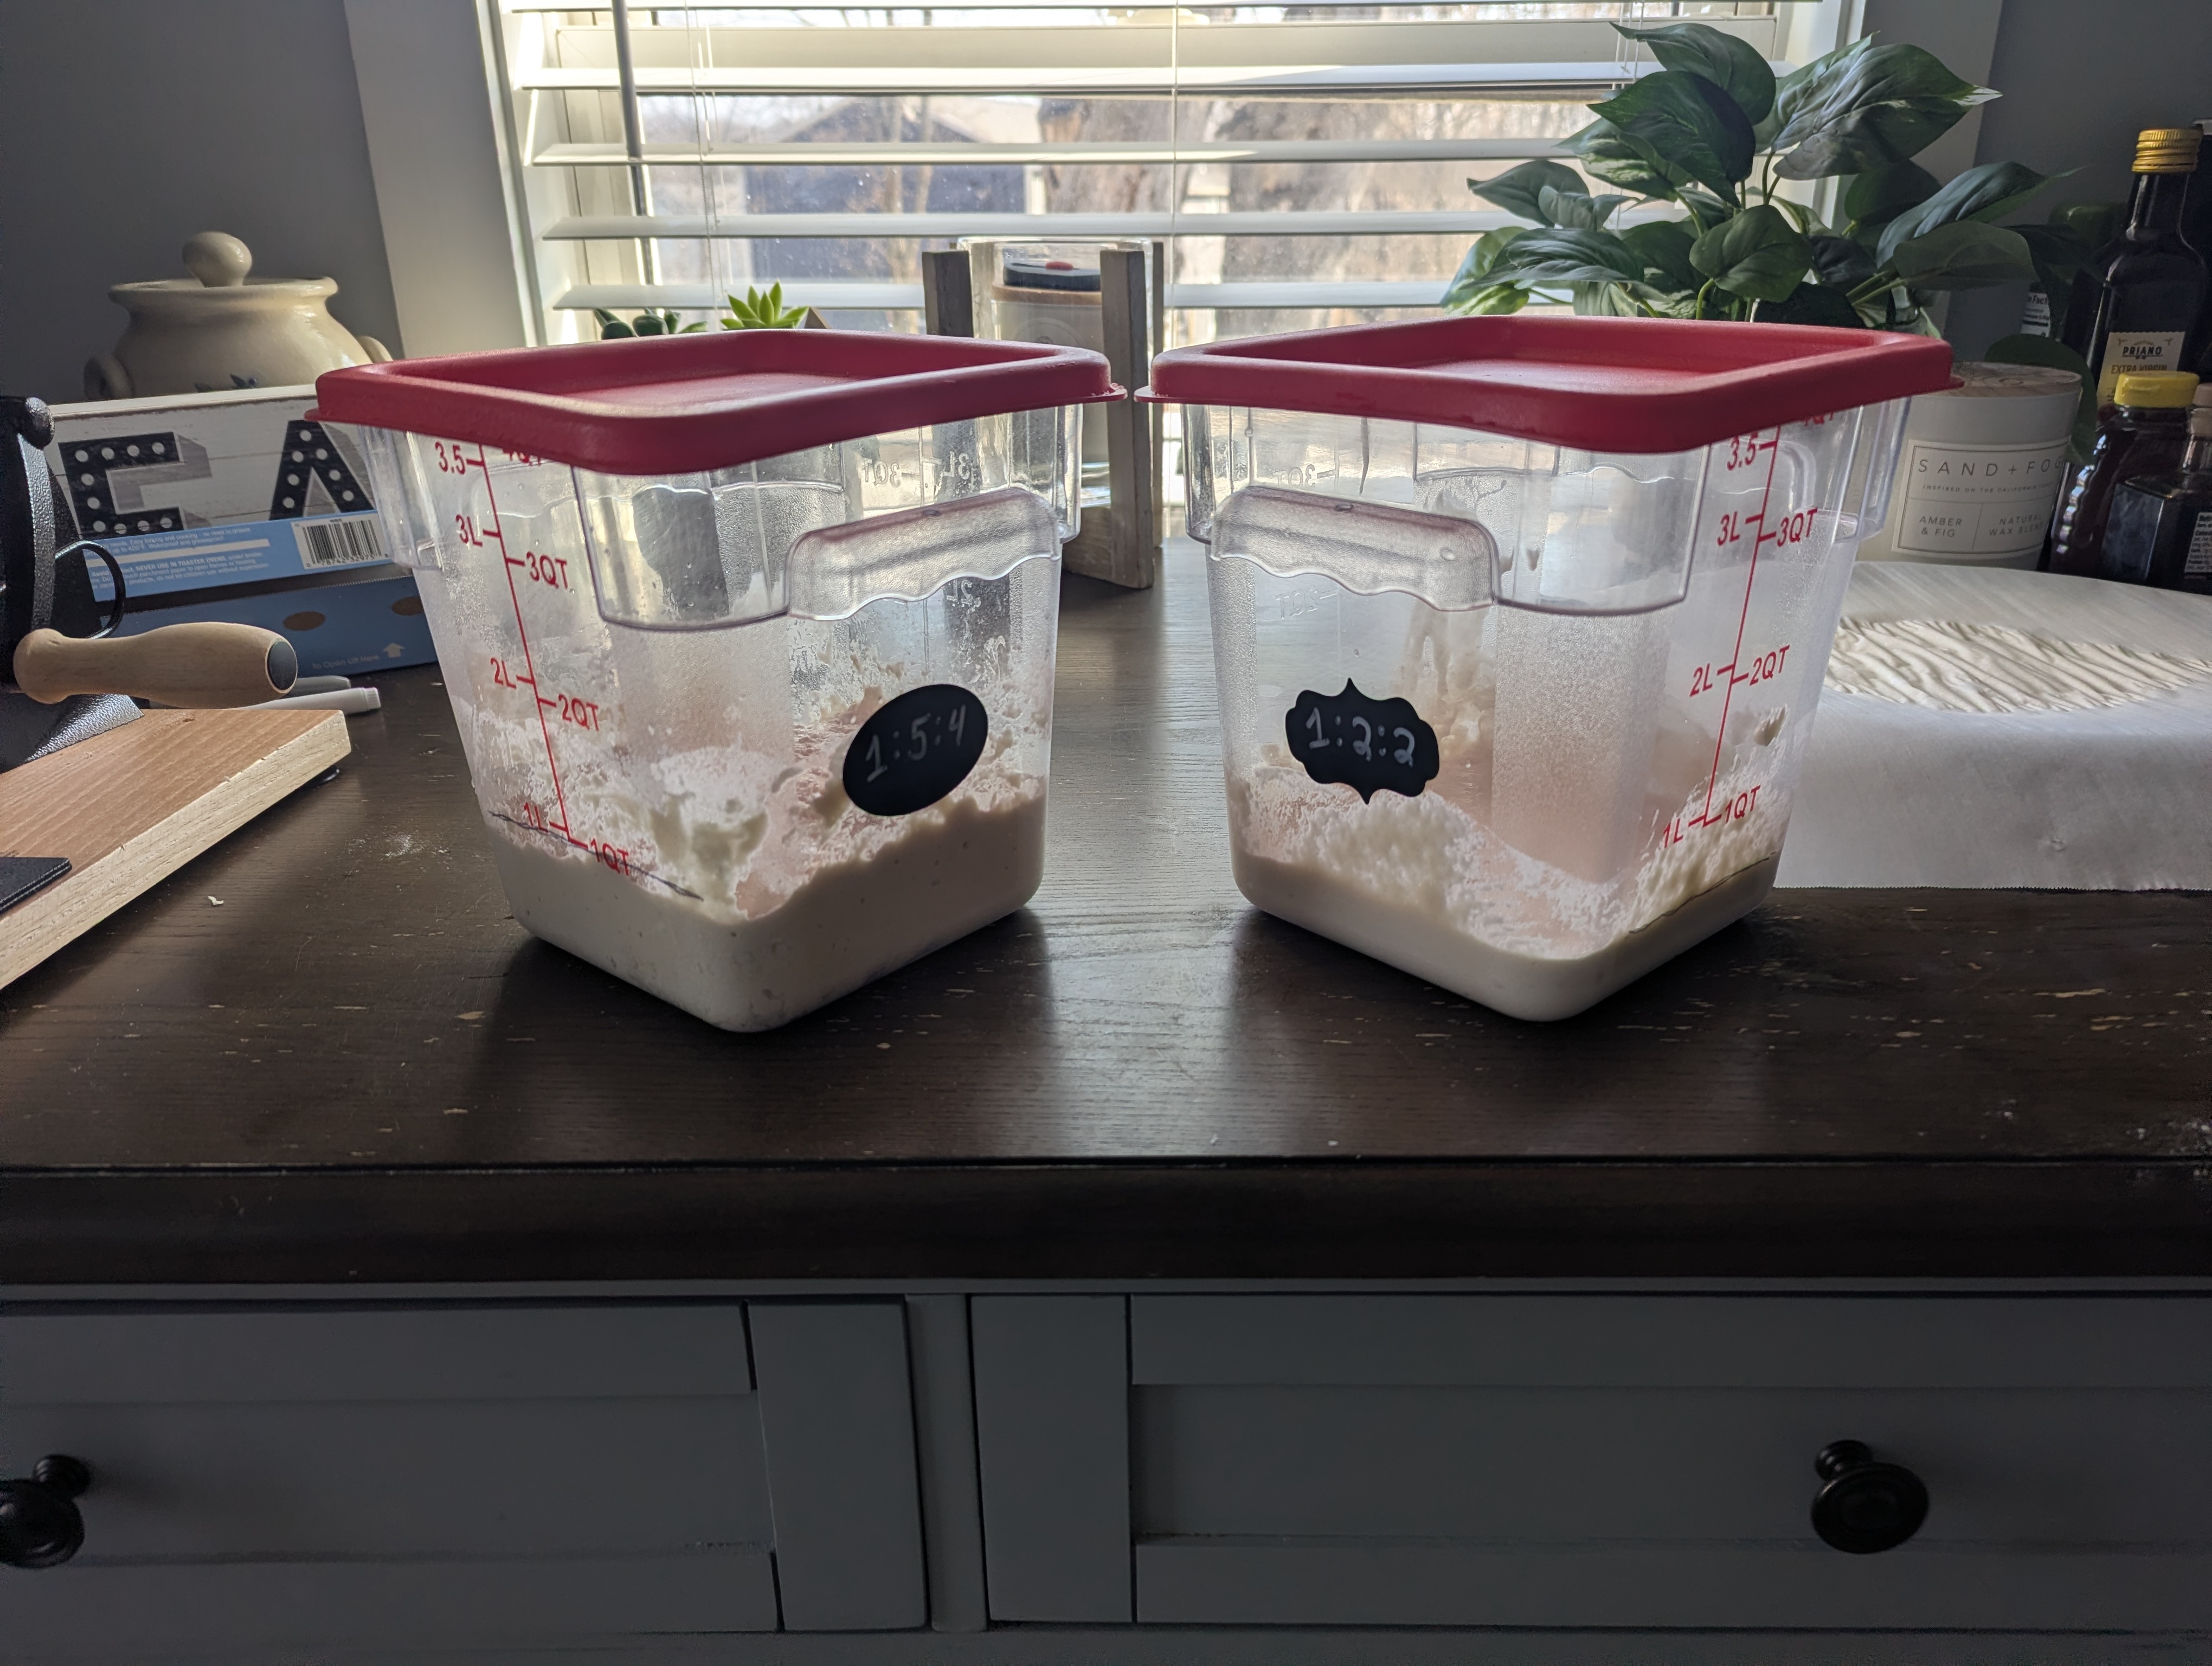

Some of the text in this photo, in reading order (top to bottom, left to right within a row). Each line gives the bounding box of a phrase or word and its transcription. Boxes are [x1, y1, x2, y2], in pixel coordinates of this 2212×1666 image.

[2123, 347, 2162, 355] PRIANO
[2111, 364, 2137, 374] EXTRA
[435, 441, 466, 475] 3.5
[1726, 432, 1758, 471] 3.5
[1918, 456, 2061, 477] SAND + FOG
[456, 515, 483, 547] 3L
[1716, 511, 1740, 546] 3L
[1777, 508, 1818, 547] 3QT
[1919, 516, 1962, 526] AMBER
[1935, 528, 1956, 537] FIG
[1989, 521, 2043, 536] WAX BLEND
[1999, 514, 2041, 525] NATURAL
[526, 551, 568, 589] 3QT
[323, 660, 346, 668] Open
[490, 657, 517, 689] 2L
[1689, 663, 1713, 697] 2L
[1749, 644, 1790, 685] 2QT
[558, 693, 600, 731] 2QT
[865, 704, 967, 783] 1:5:4
[1306, 707, 1416, 768] 1:2:2
[523, 802, 549, 833] 1L
[1725, 784, 1761, 824] 1QT
[1663, 818, 1683, 848] 1L
[590, 837, 630, 876] 1QT
